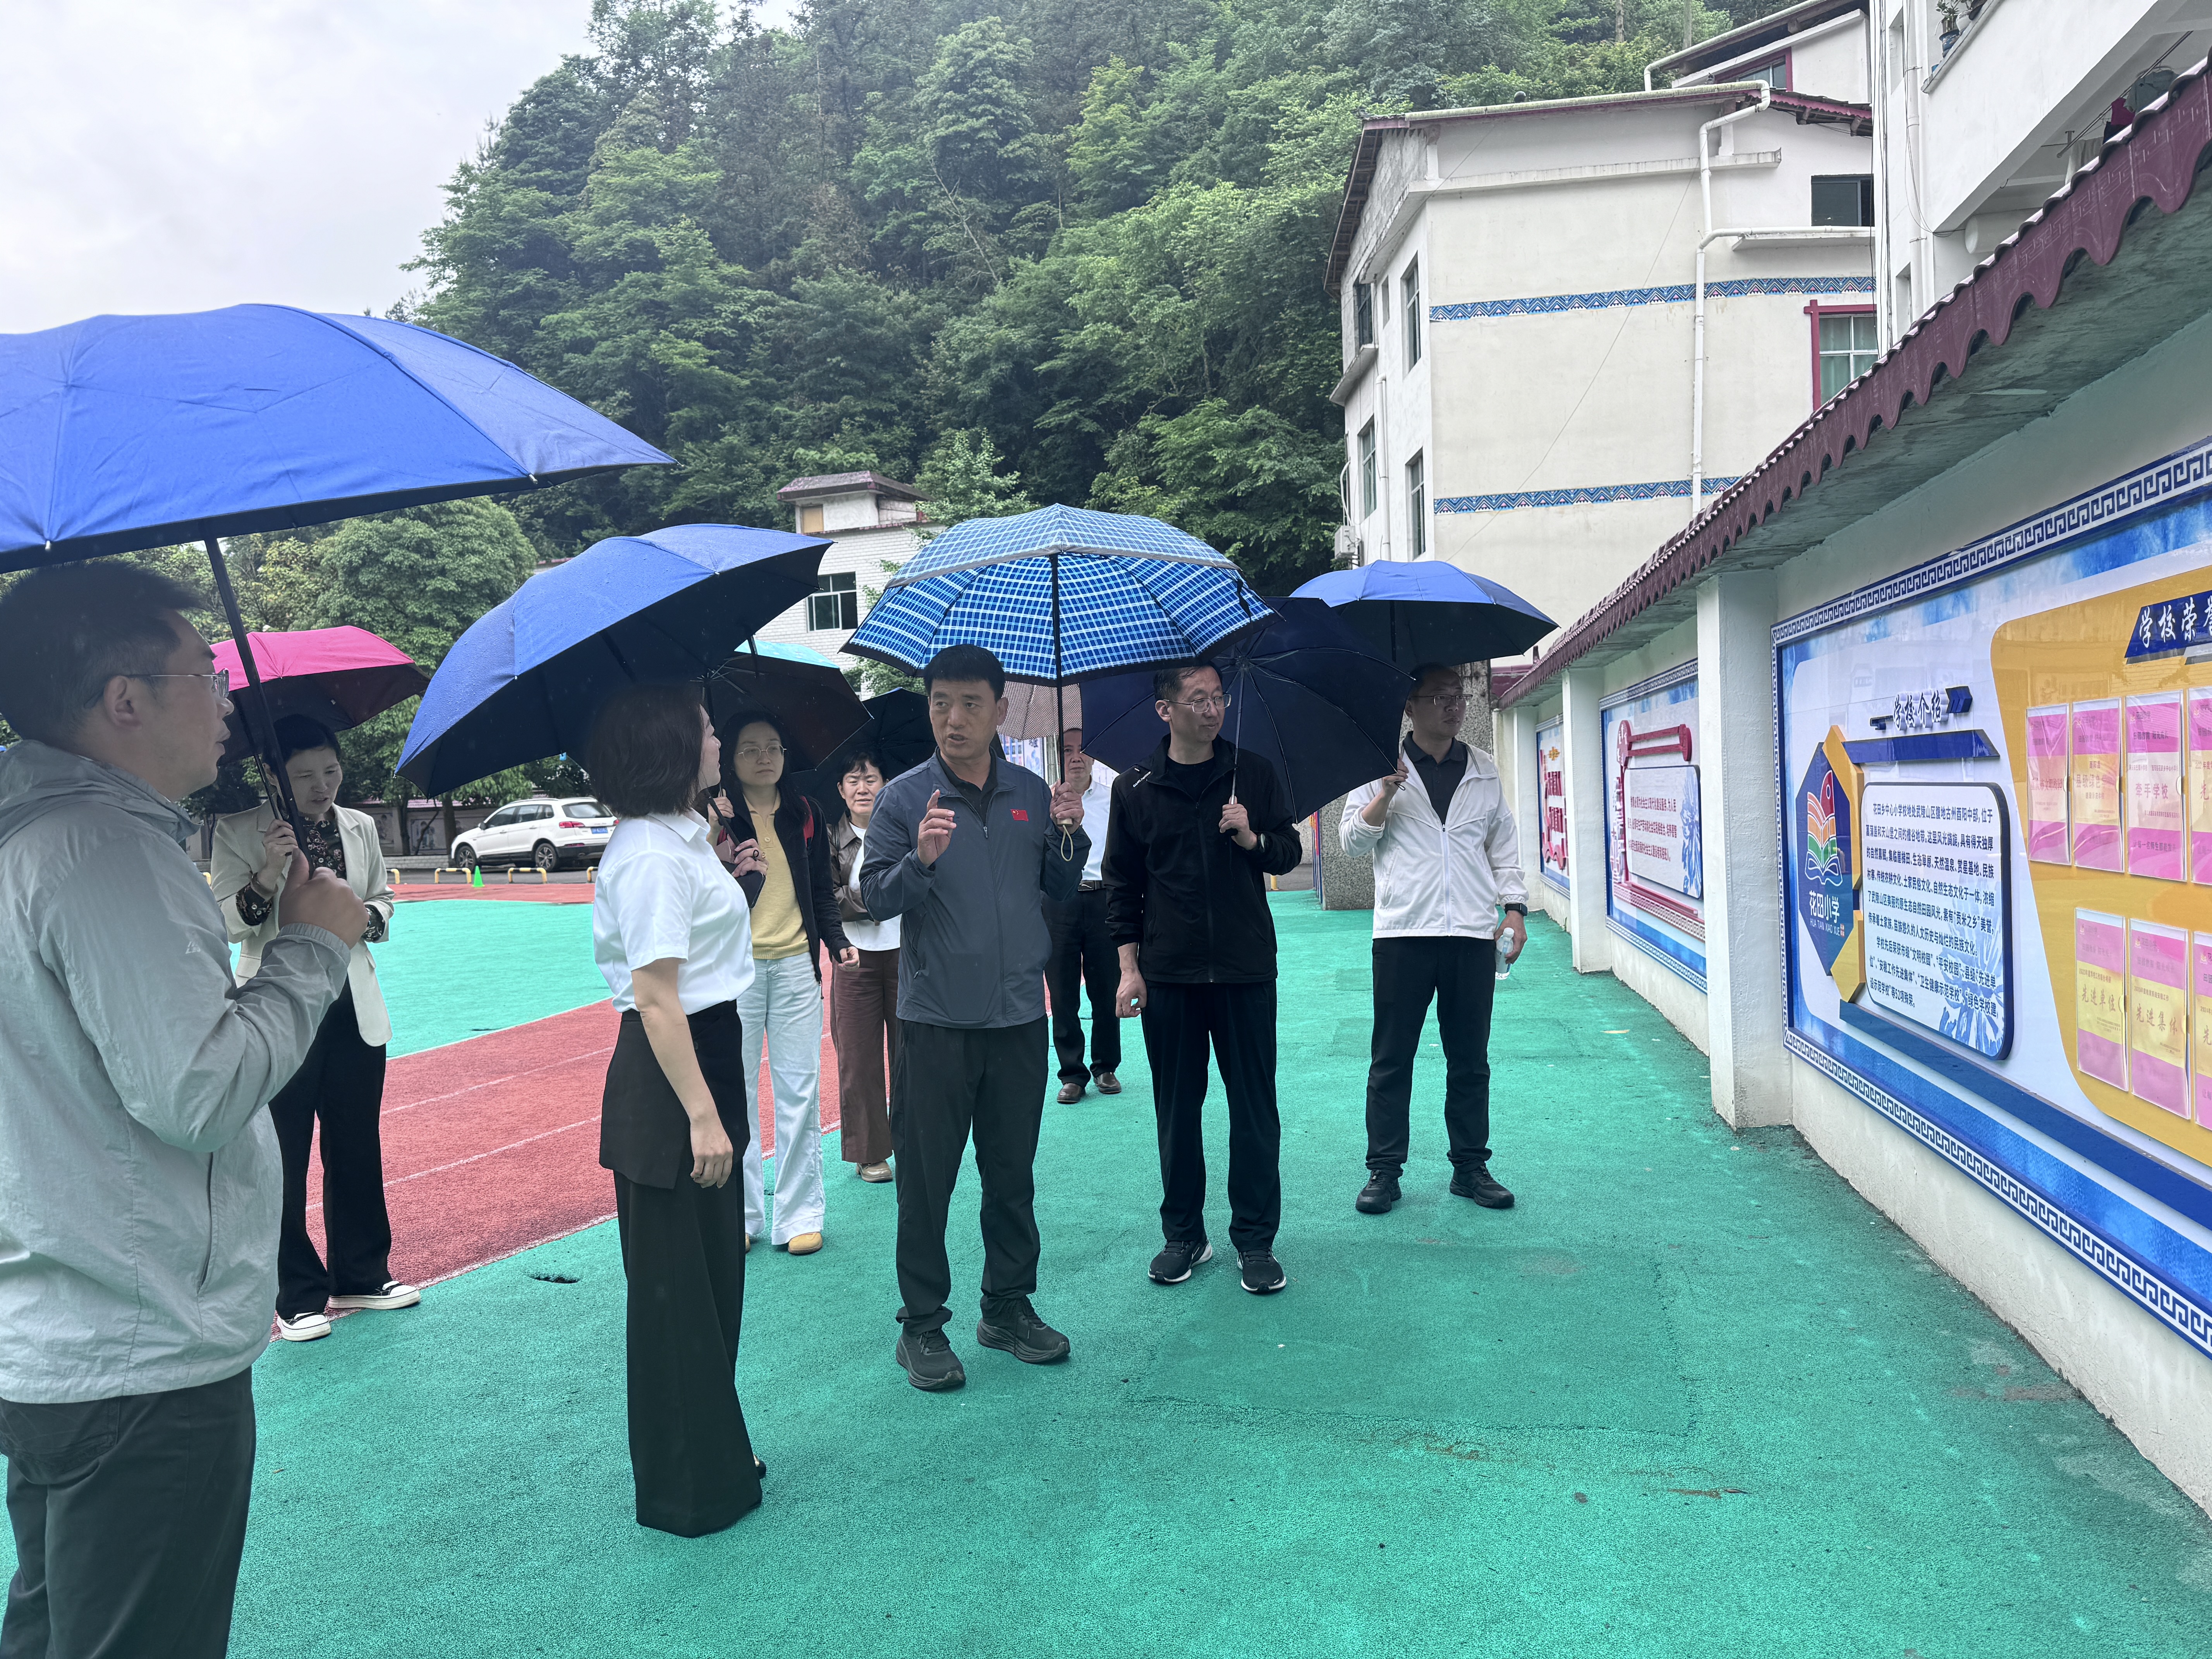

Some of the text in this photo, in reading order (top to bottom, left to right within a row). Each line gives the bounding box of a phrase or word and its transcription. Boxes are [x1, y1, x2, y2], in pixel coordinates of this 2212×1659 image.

[1894, 690, 1941, 729] 学校介绍
[2136, 782, 2169, 800] 牵手学校
[1809, 890, 1839, 923] 花田小学
[2082, 983, 2116, 1012] 先进单位
[2135, 1003, 2178, 1036] 先进集体
